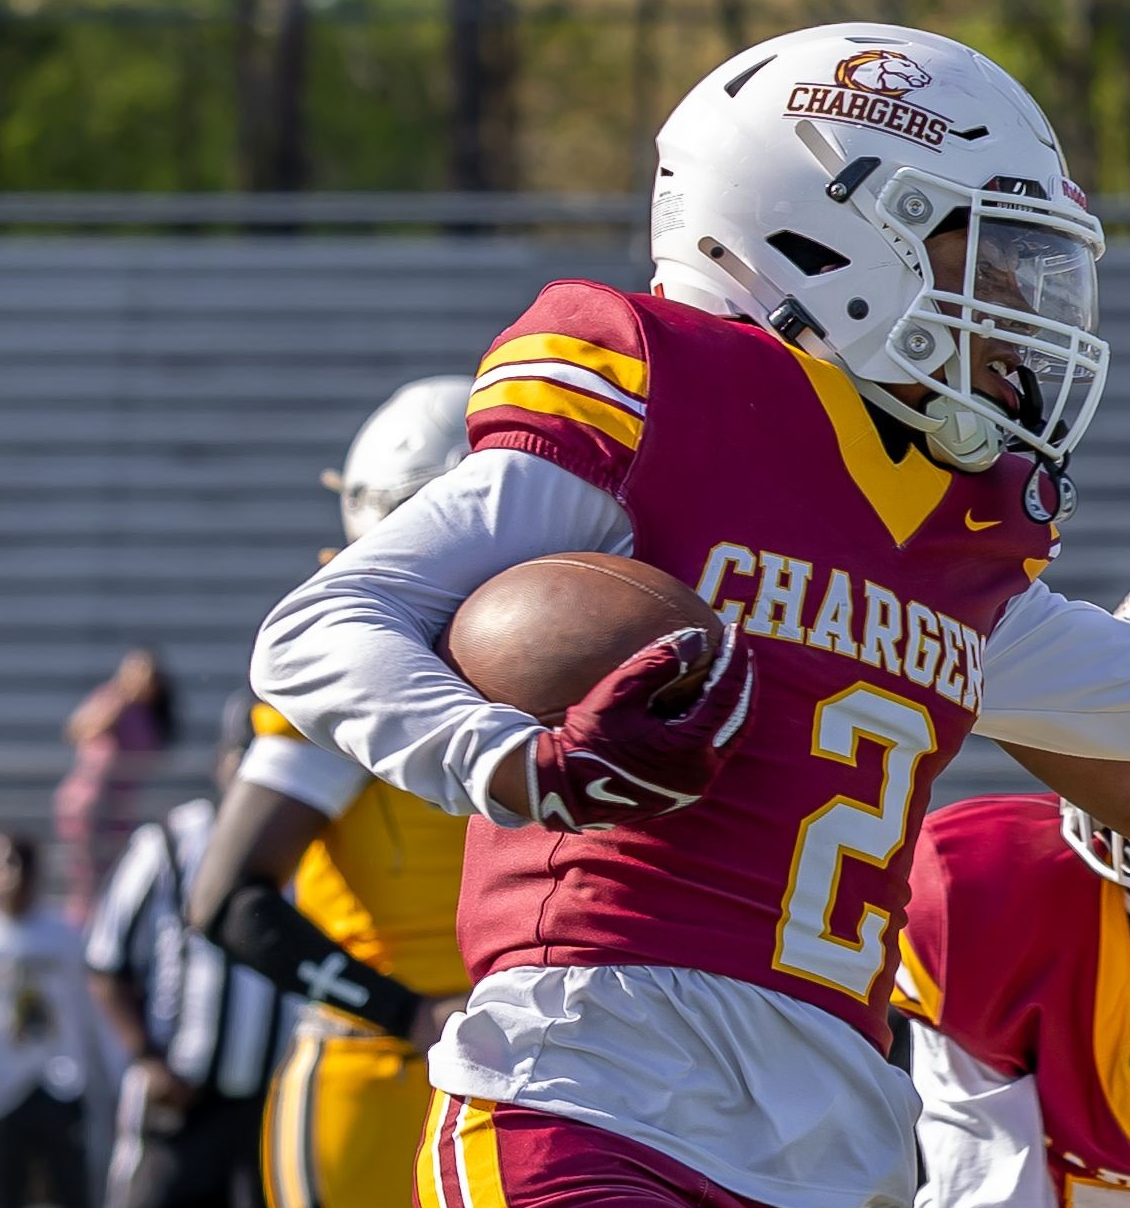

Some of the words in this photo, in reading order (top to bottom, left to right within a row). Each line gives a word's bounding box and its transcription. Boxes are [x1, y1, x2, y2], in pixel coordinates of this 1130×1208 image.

[786, 87, 947, 146] CHARGERS
[695, 541, 984, 718] CHARGER
[771, 680, 938, 1005] 2
